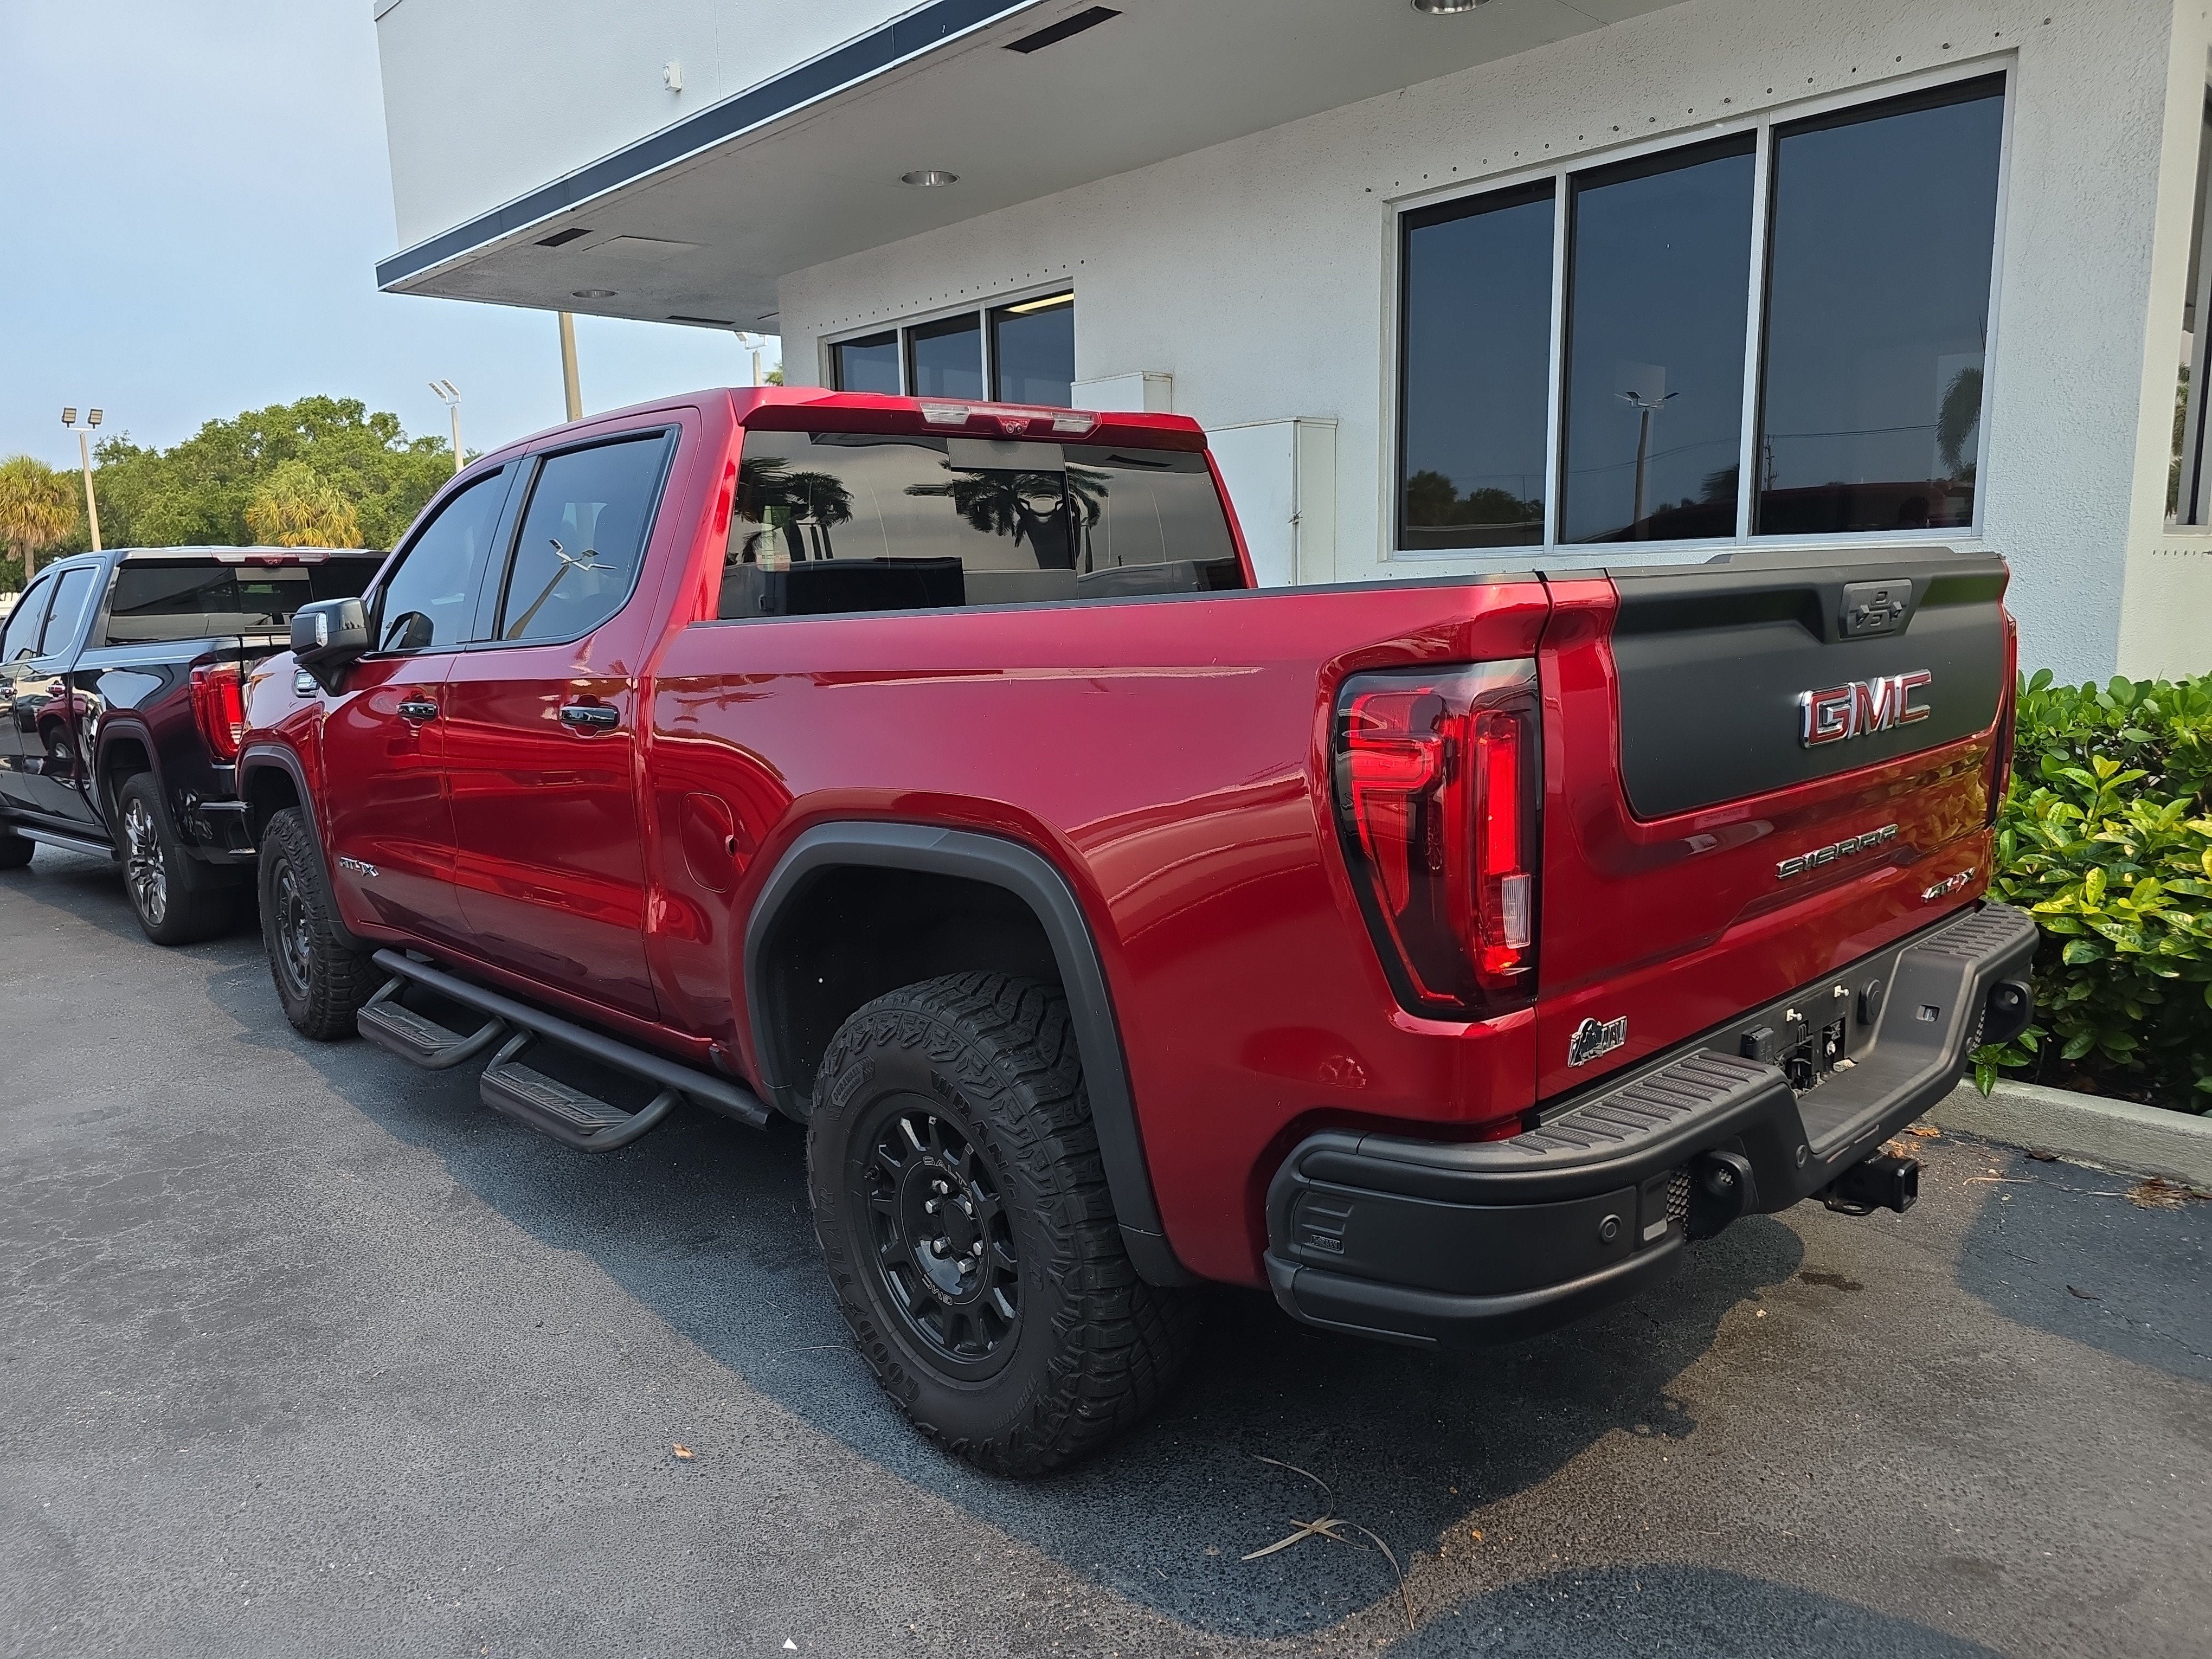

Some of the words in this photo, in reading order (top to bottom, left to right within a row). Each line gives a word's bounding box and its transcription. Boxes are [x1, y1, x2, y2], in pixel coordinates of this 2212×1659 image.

[1800, 669, 1932, 749] GMC
[1775, 824, 1899, 879] SIERRA
[1921, 866, 1976, 899] AT4X
[922, 1155, 974, 1205] SALTA
[930, 1068, 1044, 1292] WRANGLER
[819, 1186, 919, 1402] GOODYEAR
[922, 1273, 953, 1307] GMC
